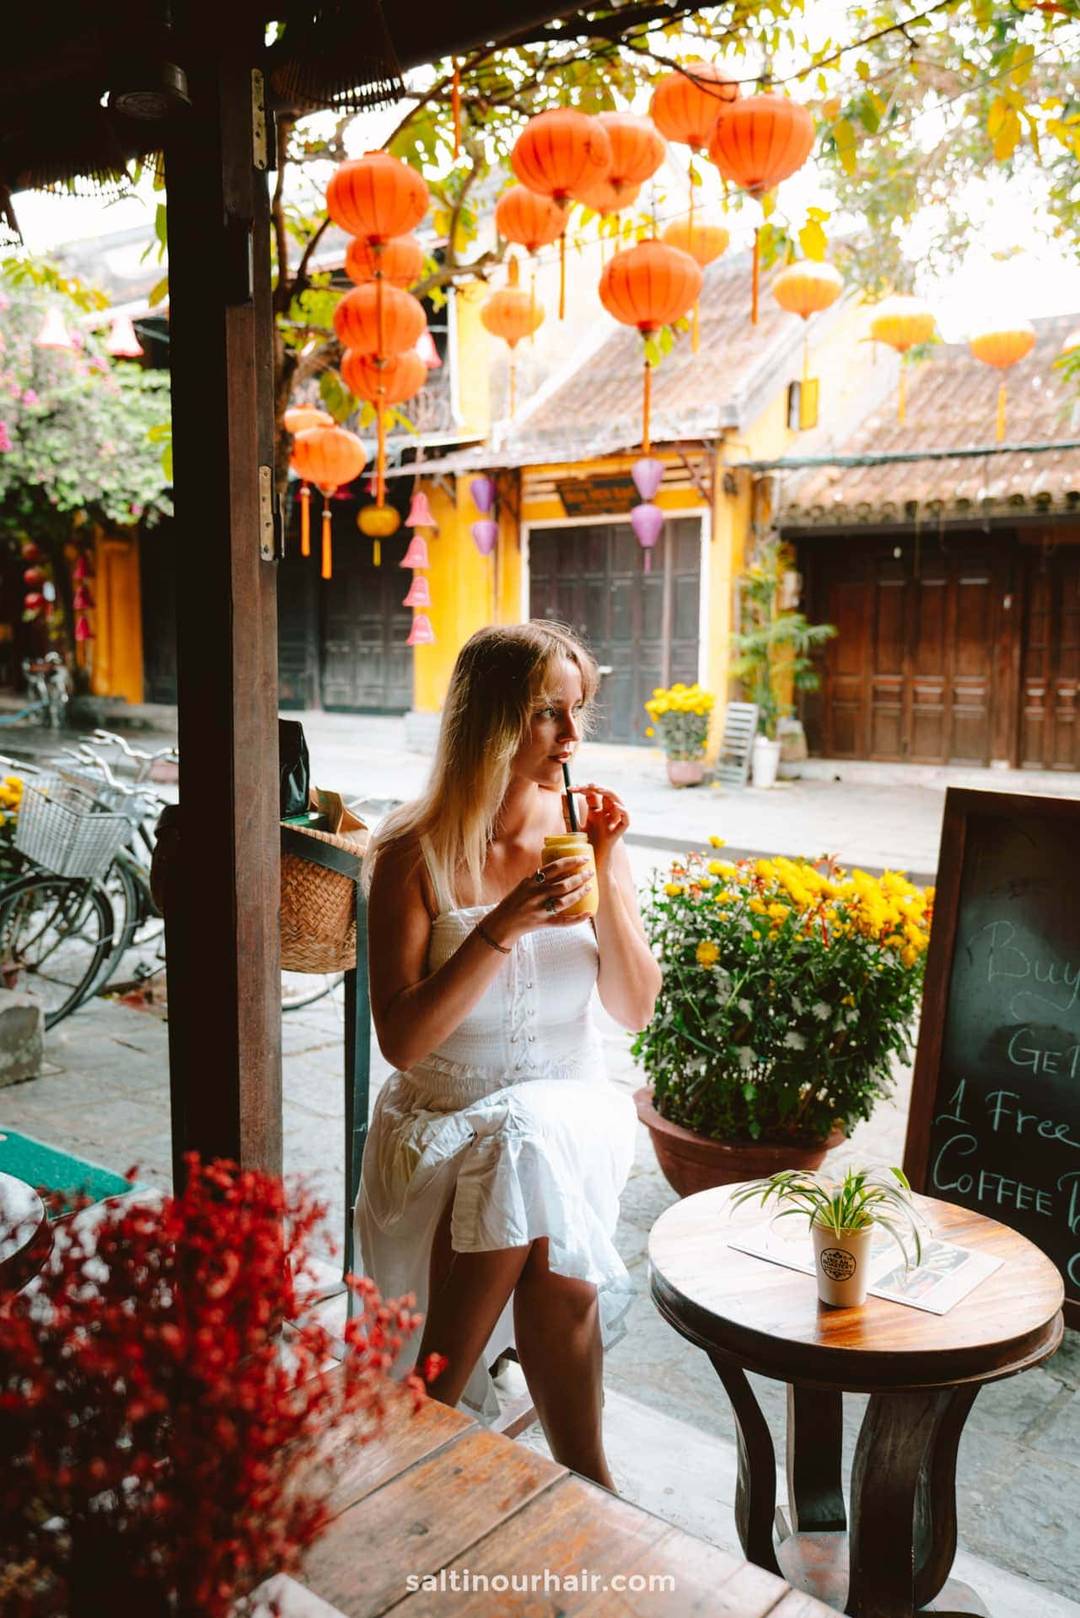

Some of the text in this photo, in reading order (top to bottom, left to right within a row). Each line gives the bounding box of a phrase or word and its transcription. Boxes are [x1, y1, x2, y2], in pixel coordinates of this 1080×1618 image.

[984, 920, 1080, 1012] Buy
[936, 1078, 1080, 1147] 1 Free
